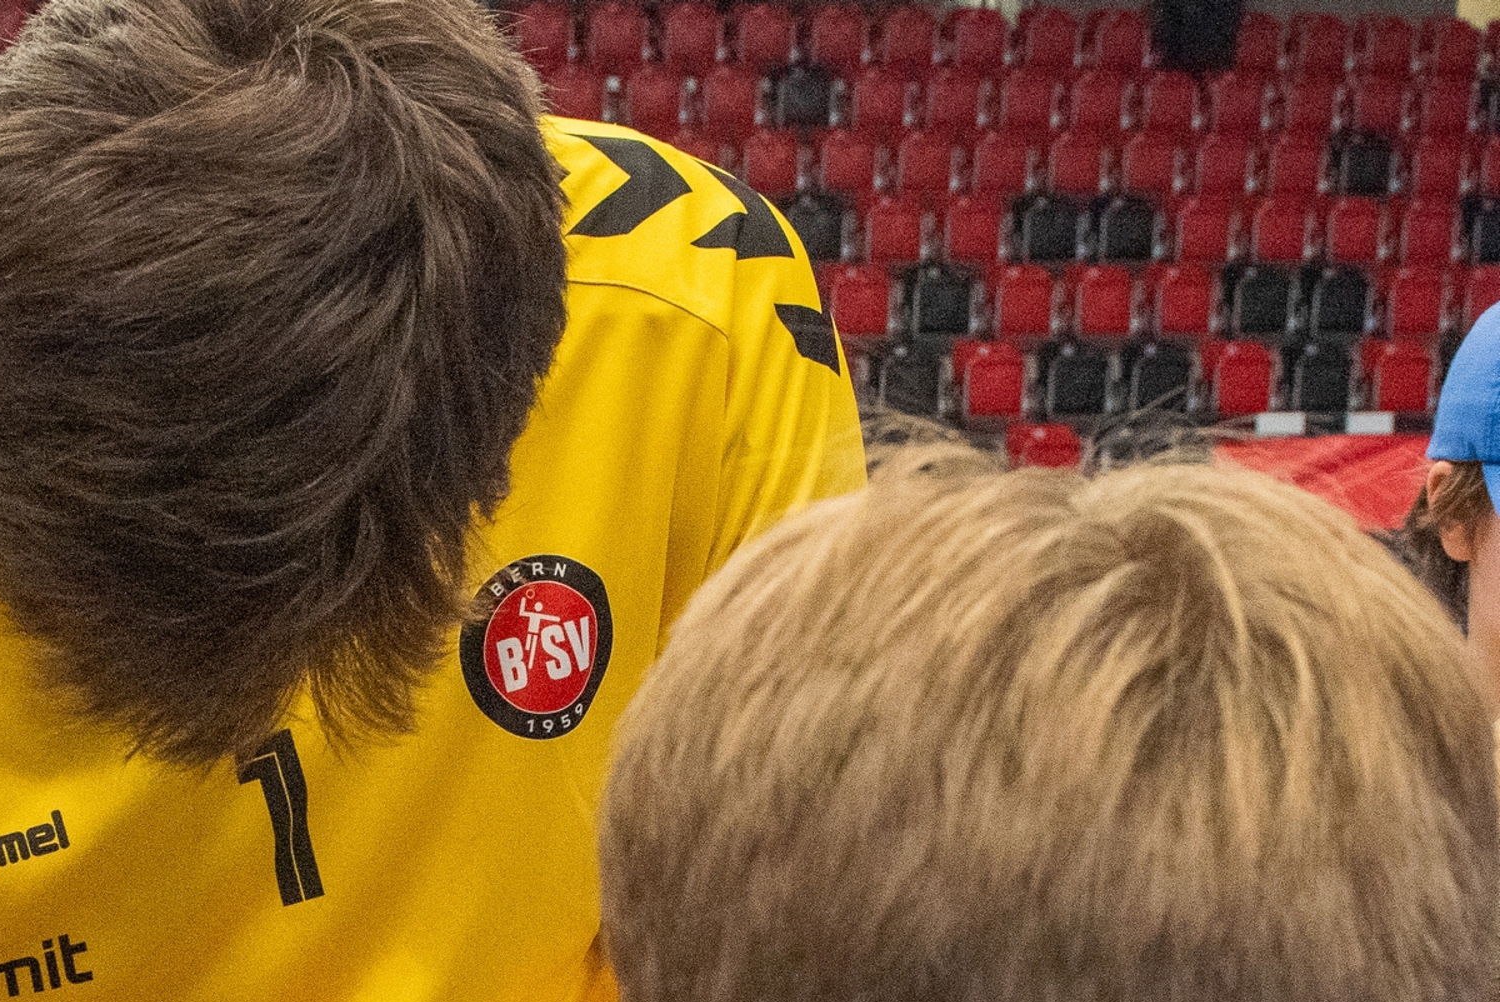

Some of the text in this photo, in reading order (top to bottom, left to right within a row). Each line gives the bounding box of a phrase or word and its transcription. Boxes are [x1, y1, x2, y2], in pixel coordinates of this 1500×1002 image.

[489, 561, 567, 597] BERN
[526, 703, 583, 732] 1959
[238, 728, 325, 907] 1
